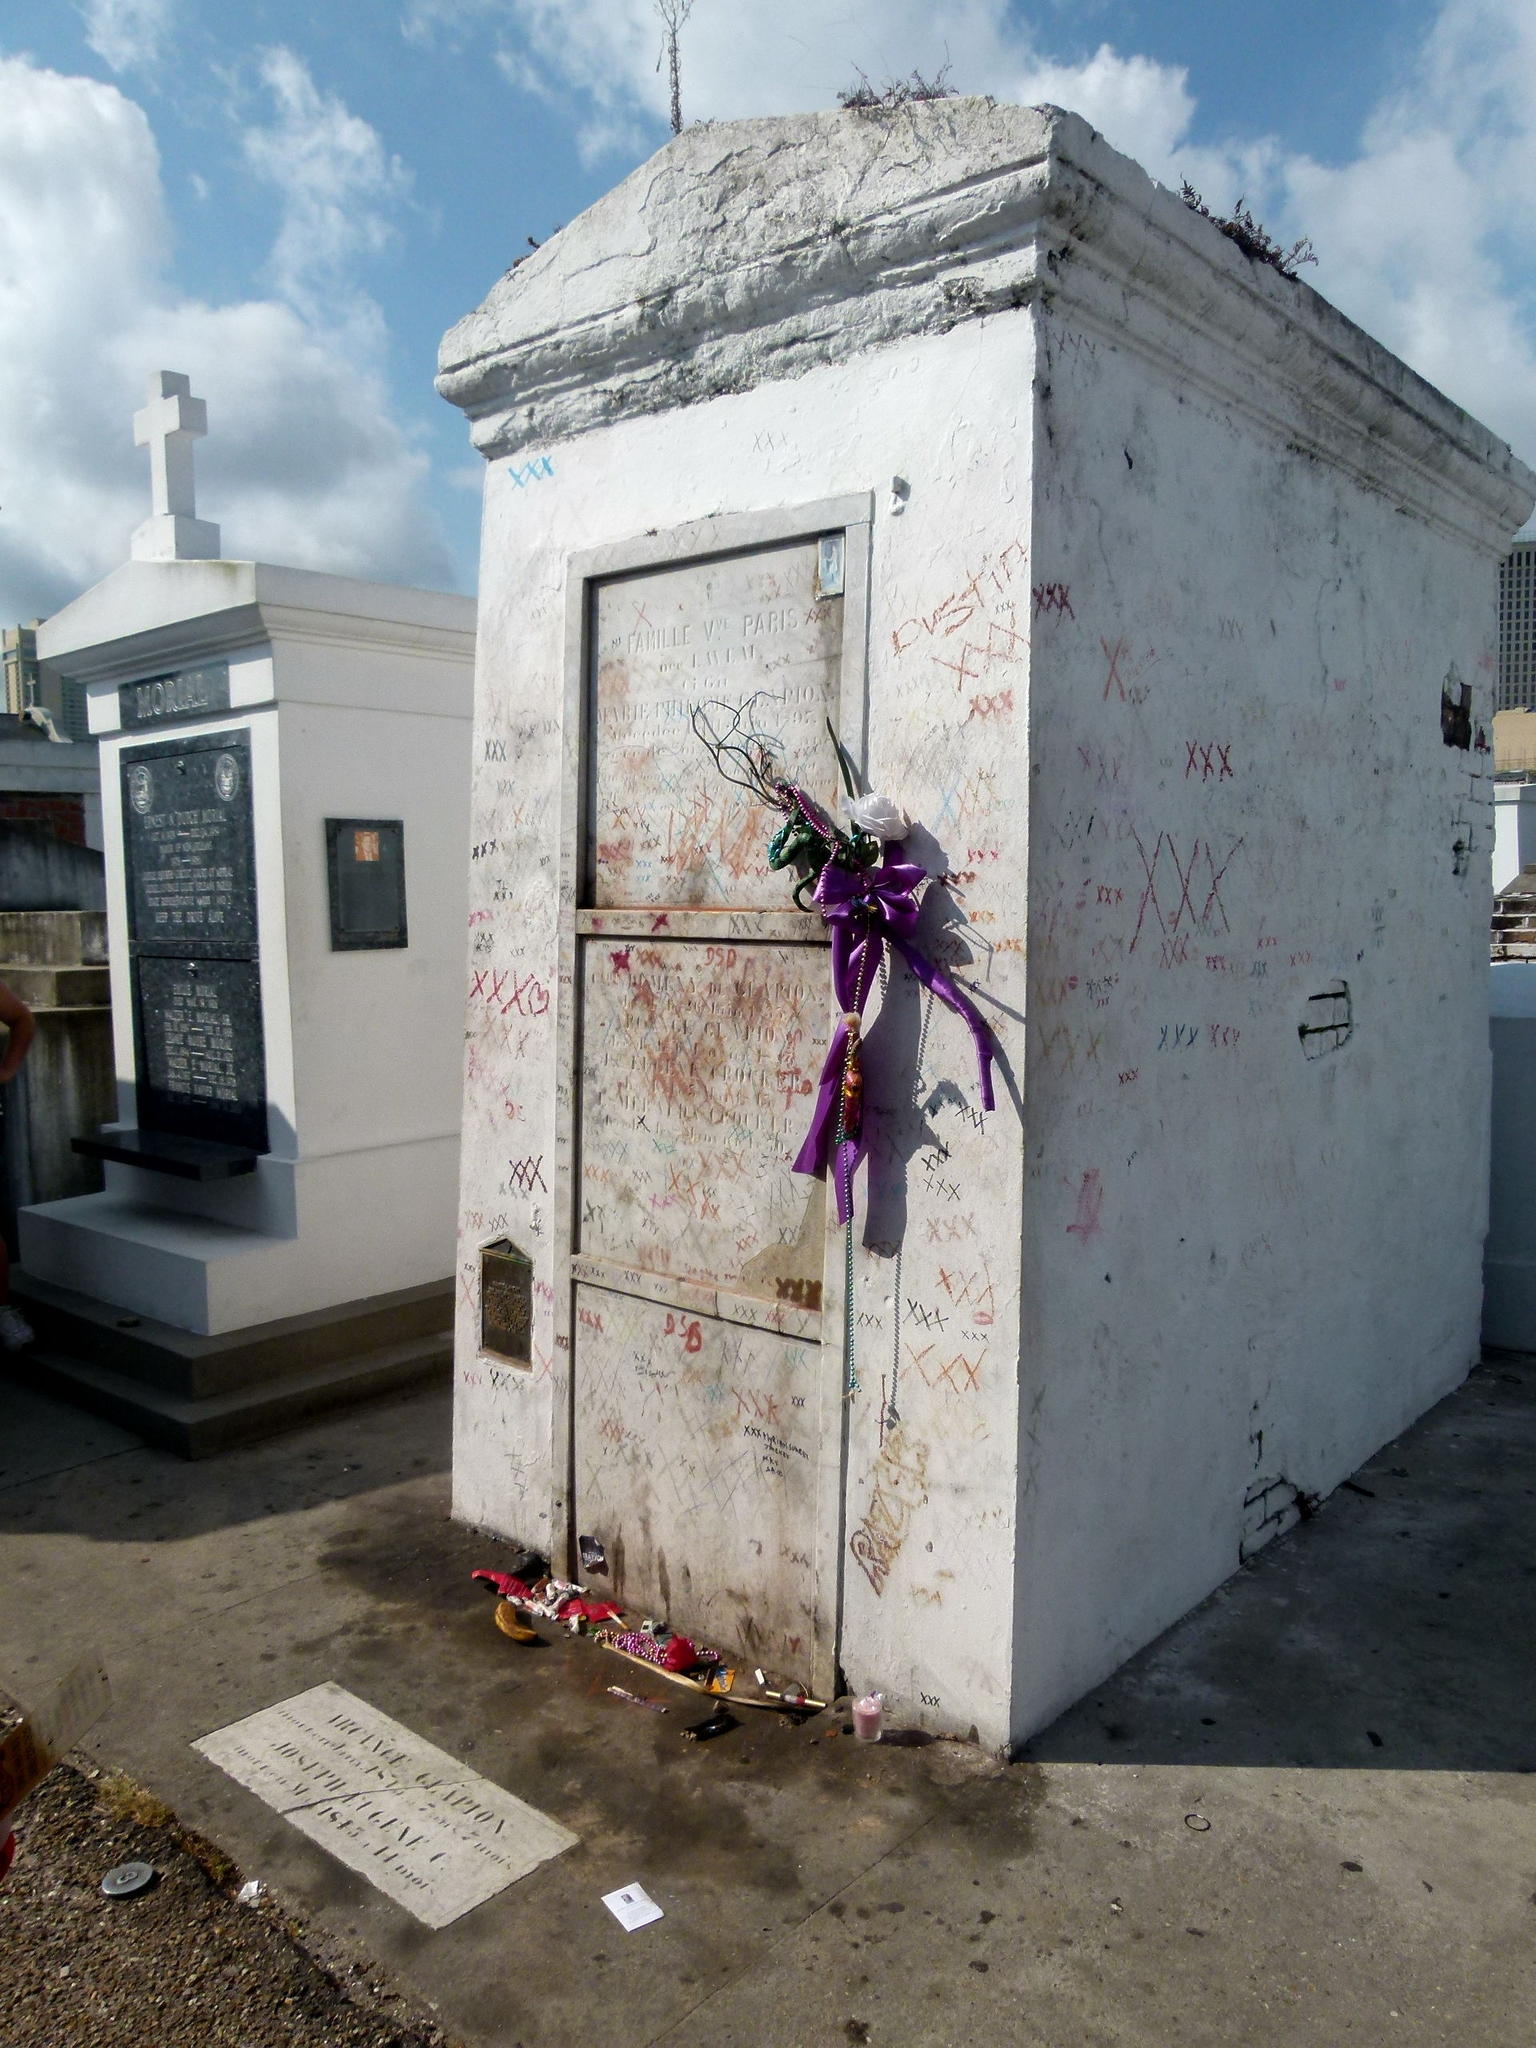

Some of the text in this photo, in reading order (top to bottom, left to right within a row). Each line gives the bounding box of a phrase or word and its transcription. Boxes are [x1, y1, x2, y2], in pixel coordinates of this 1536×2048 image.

[508, 456, 555, 490] XXX
[1032, 583, 1075, 628] XXX
[627, 625, 692, 655] FAMILLE
[743, 607, 798, 637] PARIS
[136, 673, 209, 719] MORIAL
[485, 740, 507, 762] XXX
[1185, 740, 1234, 783] XXX
[1096, 885, 1123, 904] XXX
[1129, 824, 1245, 954] XXX
[470, 969, 535, 1016] XXX
[921, 1141, 953, 1172] XXX
[509, 1154, 548, 1193] XXX
[923, 1174, 961, 1201] XXX
[624, 1270, 641, 1284] XXX
[857, 1312, 883, 1329] XXX
[903, 1298, 949, 1332] XXX
[962, 1330, 990, 1343] XXX
[791, 1395, 806, 1407] XXX
[921, 1692, 940, 1707] XXX
